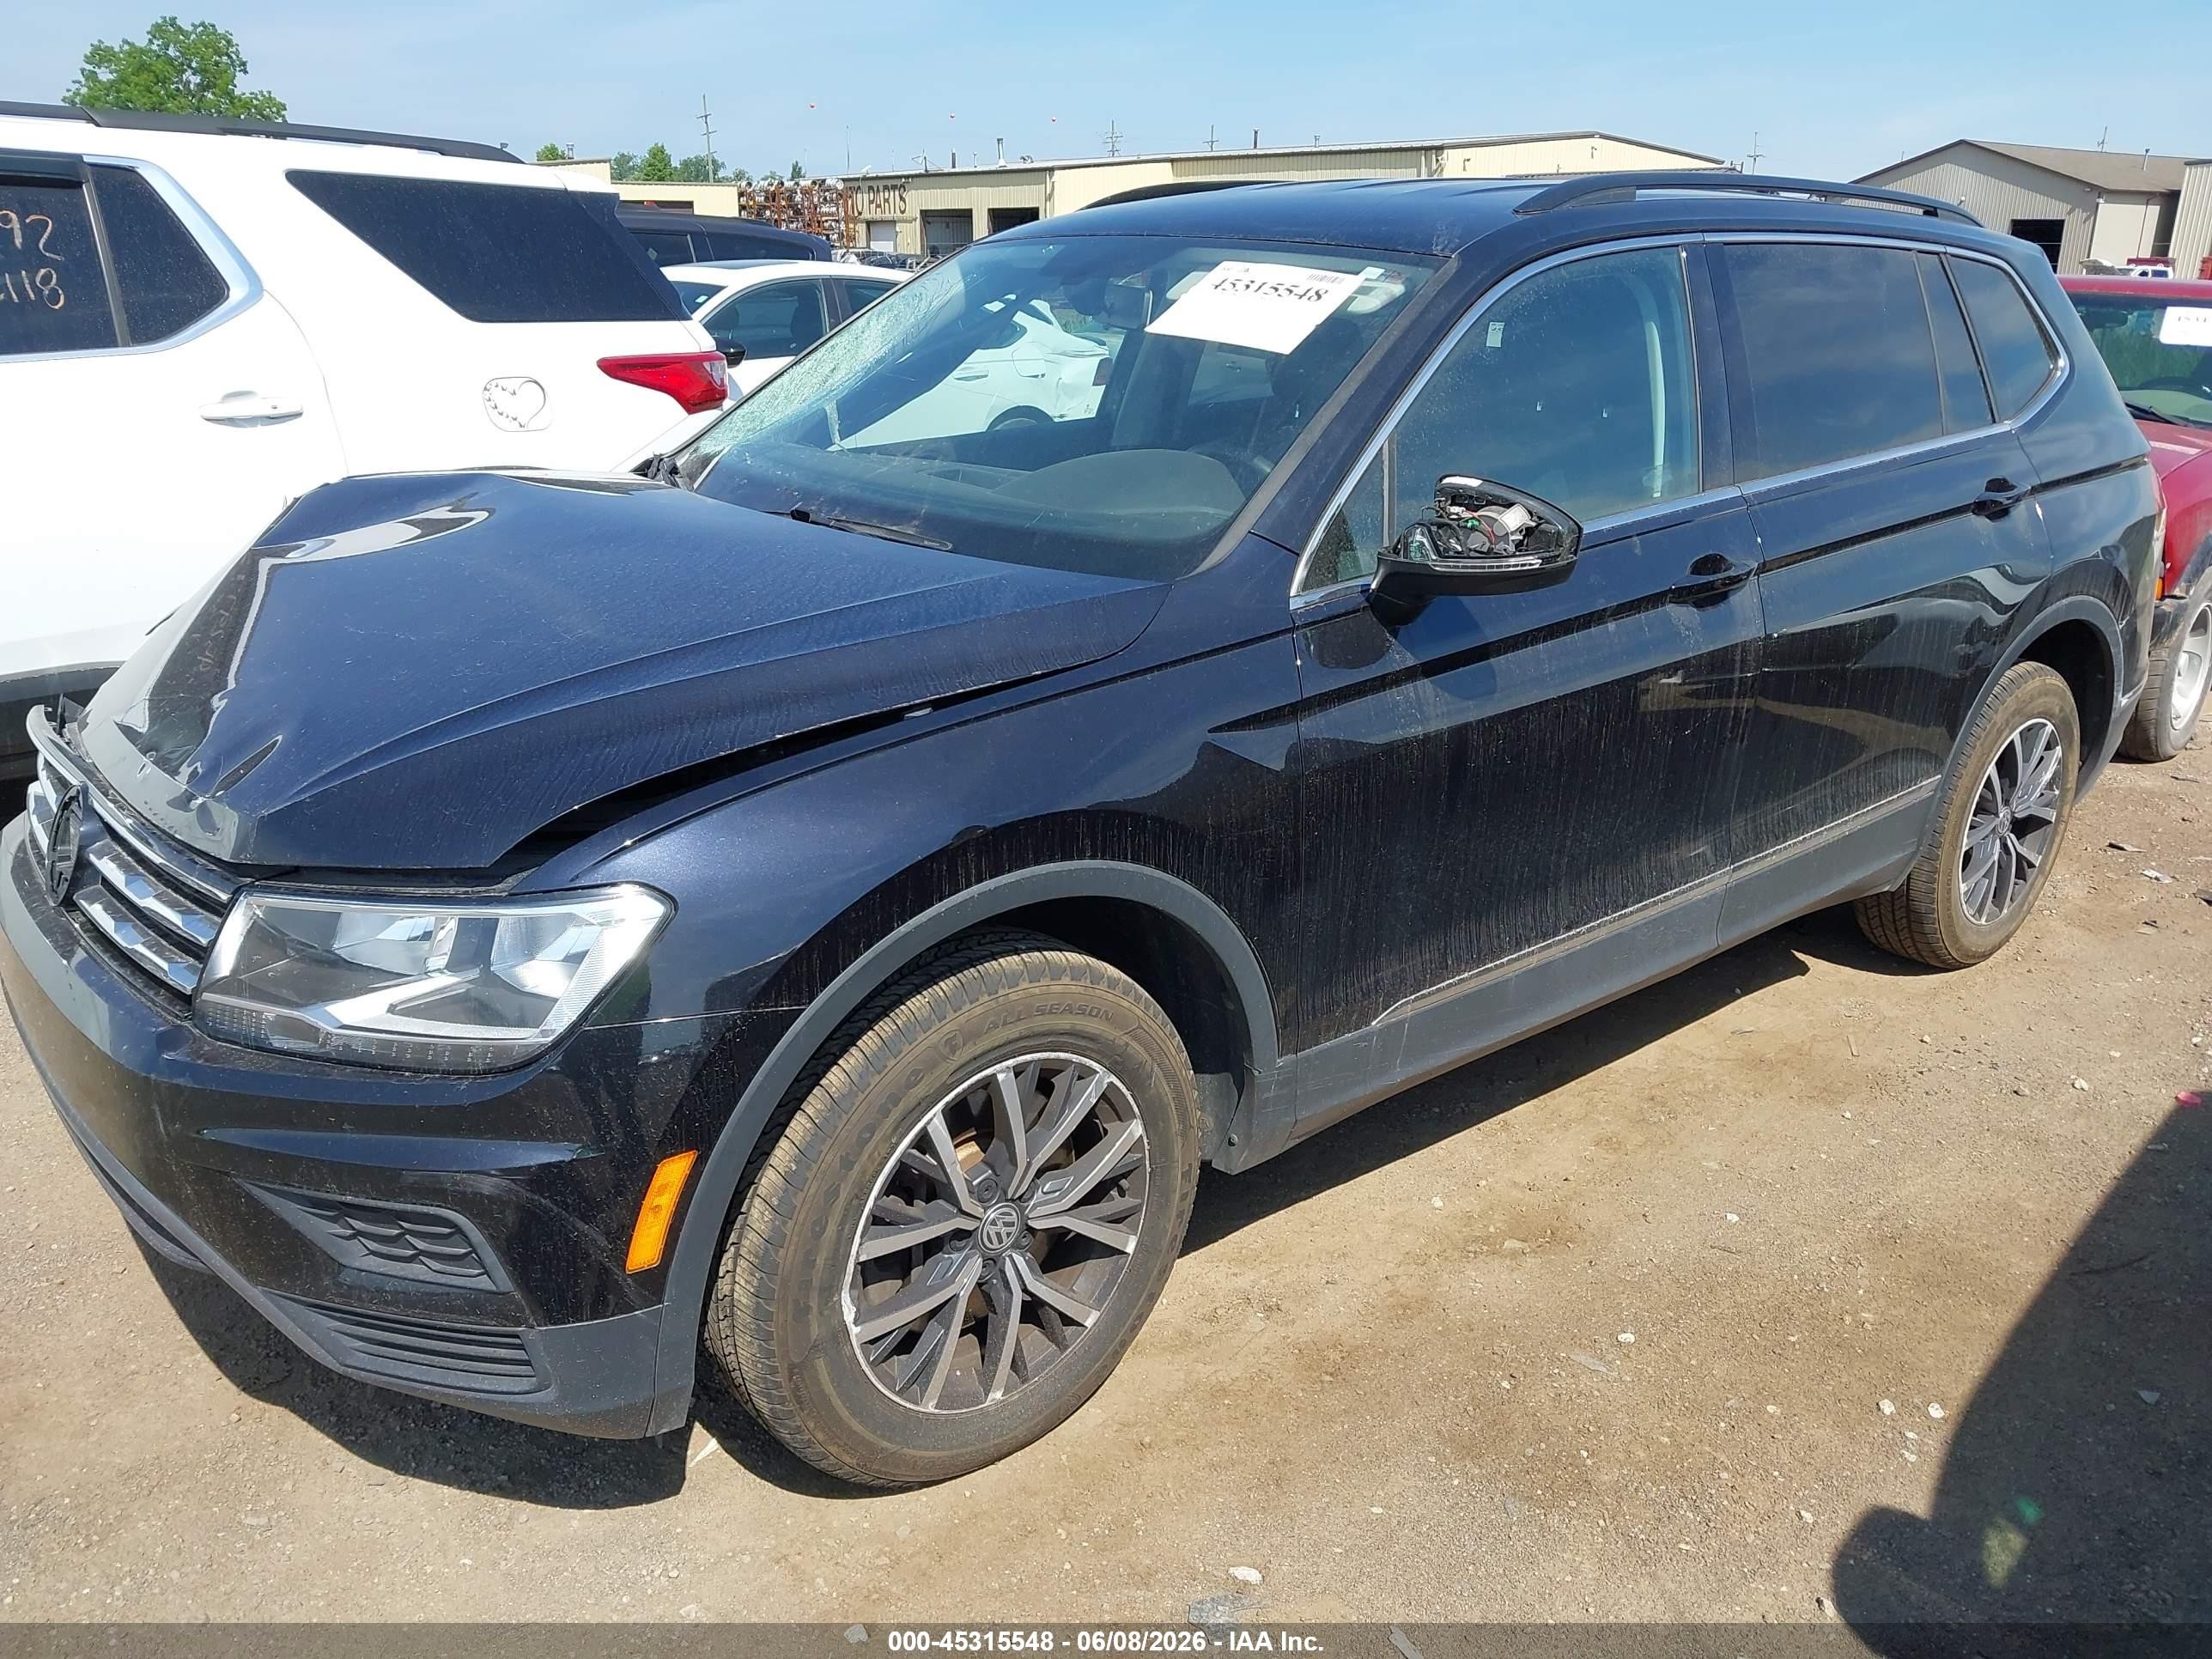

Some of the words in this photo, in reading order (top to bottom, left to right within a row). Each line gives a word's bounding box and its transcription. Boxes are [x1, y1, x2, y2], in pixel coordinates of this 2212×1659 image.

[867, 184, 907, 215] PARTS
[0, 267, 65, 310] 118
[1212, 277, 1328, 301] 45315548
[983, 1008, 1028, 1034] ALL
[1033, 1001, 1115, 1022] SEASON
